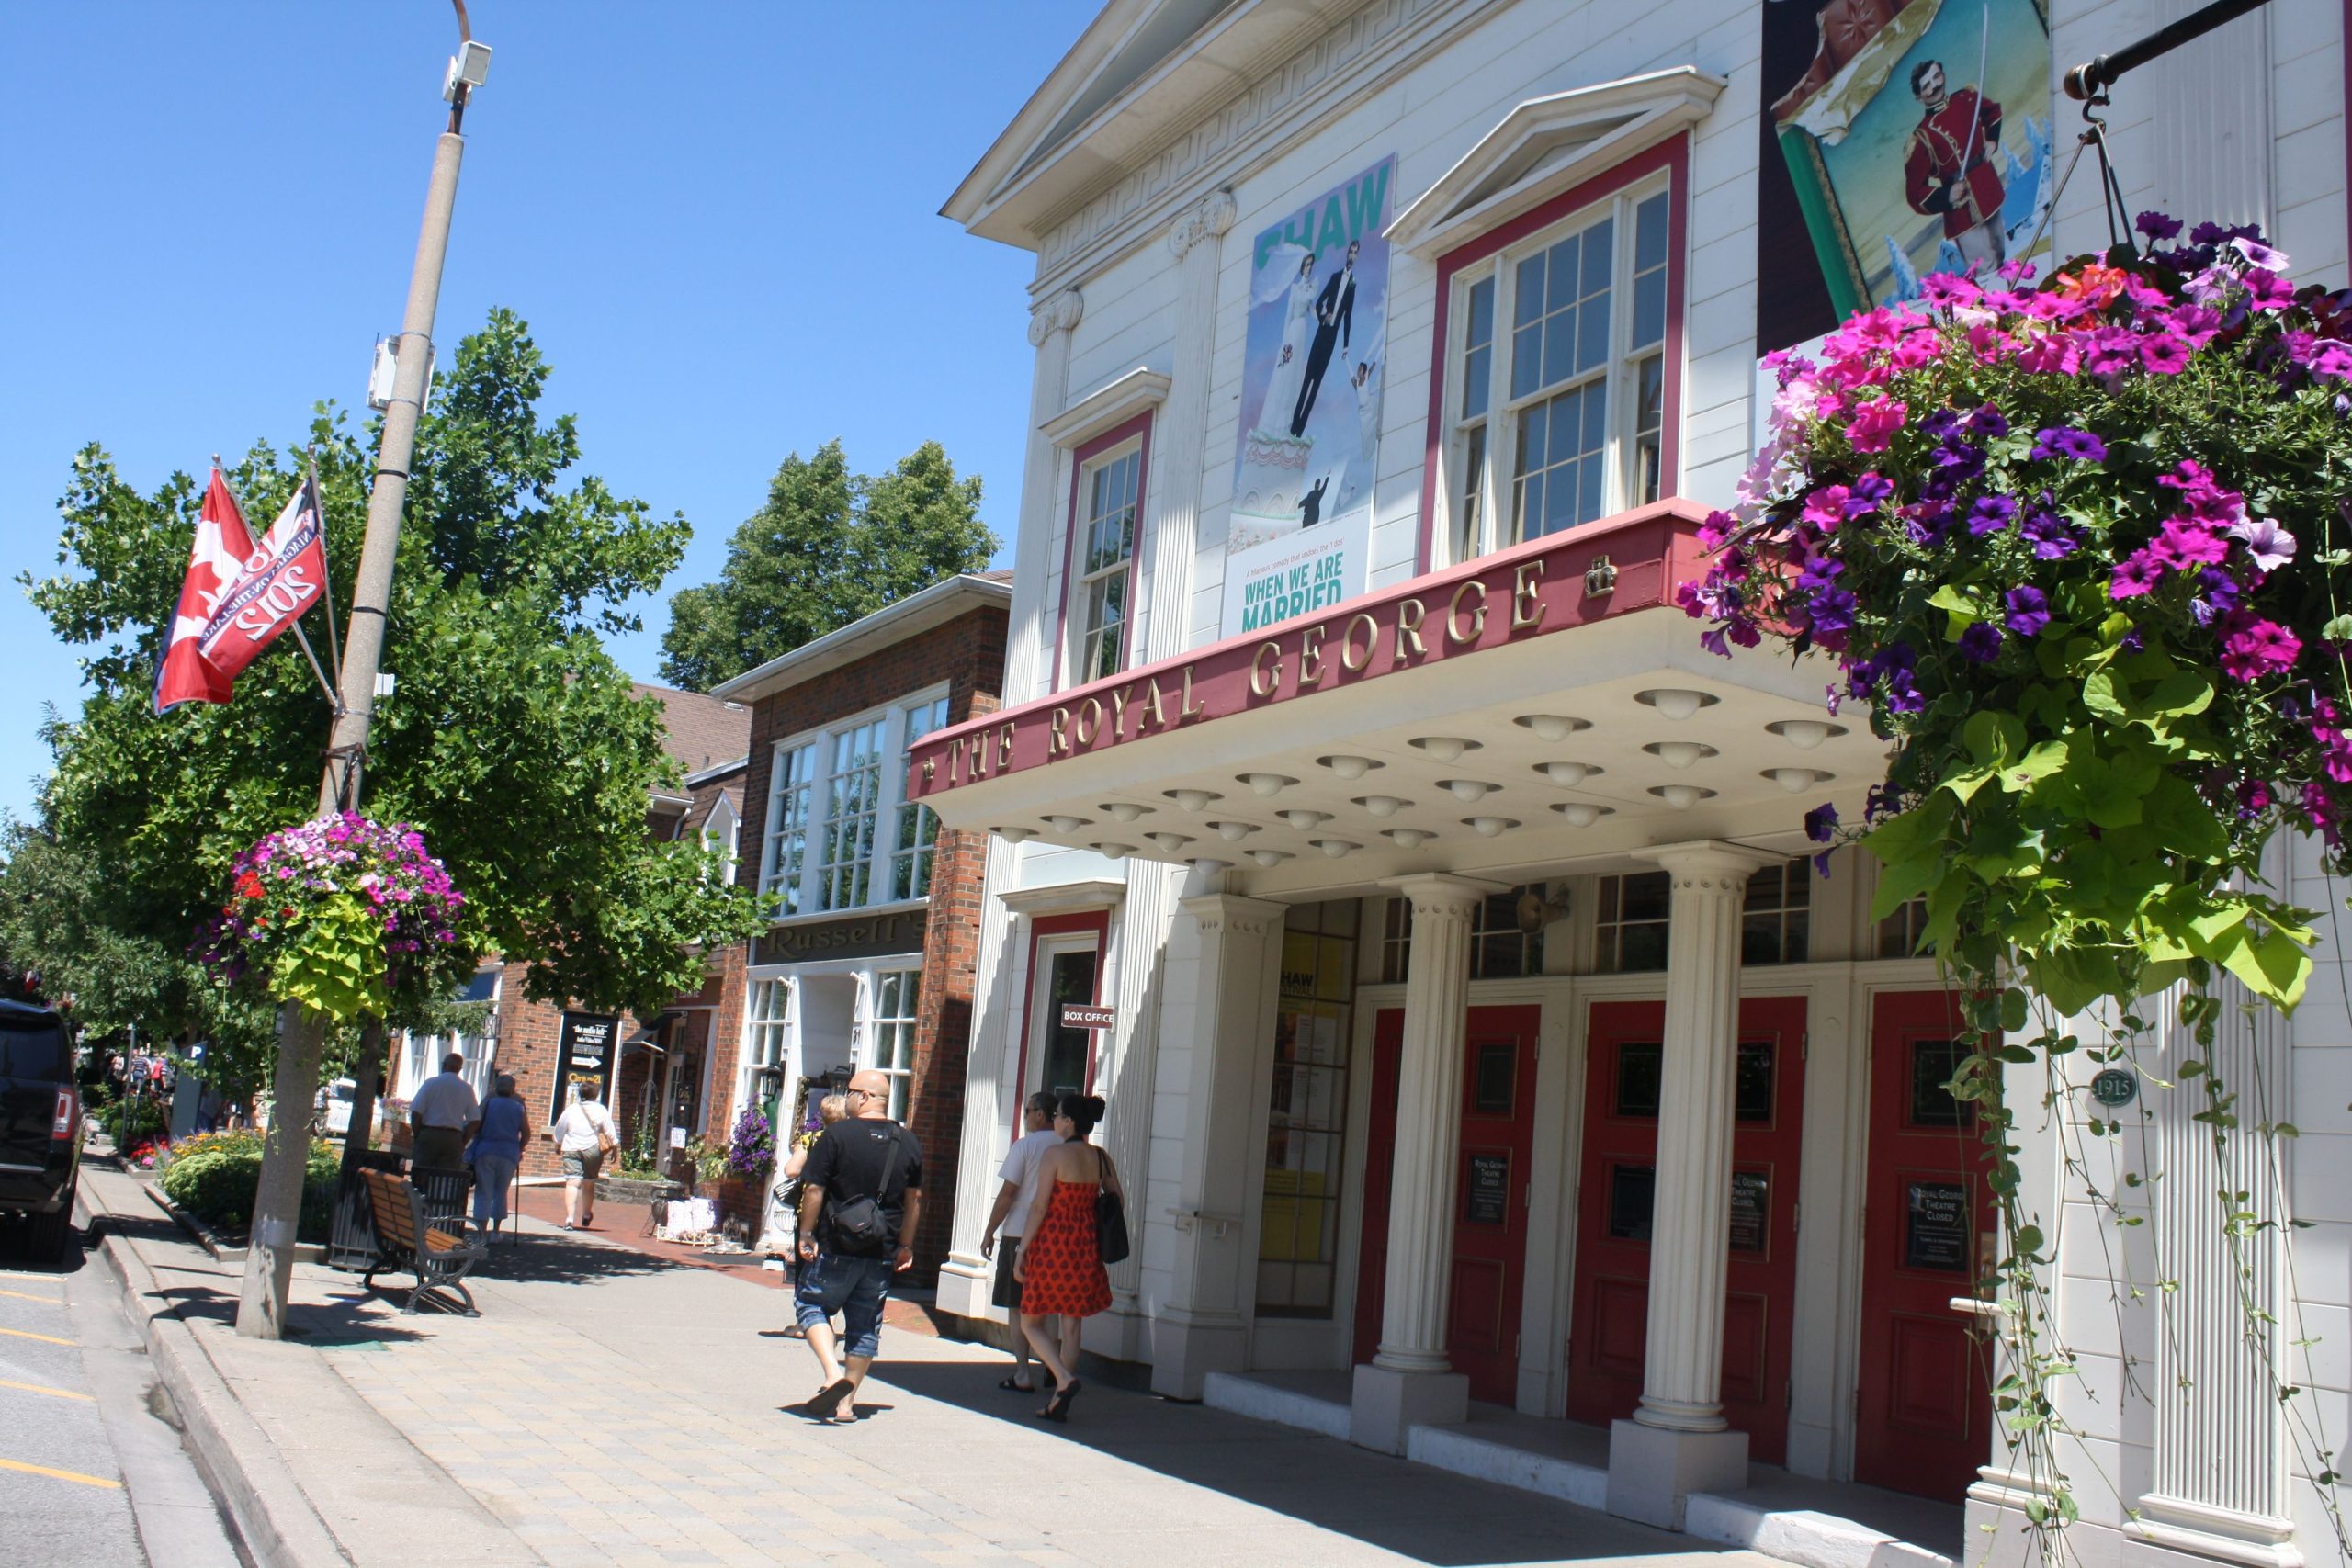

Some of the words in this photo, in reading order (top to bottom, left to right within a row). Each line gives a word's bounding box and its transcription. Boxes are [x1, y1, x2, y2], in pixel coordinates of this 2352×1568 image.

[1250, 564, 1271, 575] hilarious
[1271, 558, 1290, 571] comedy
[1290, 553, 1301, 563] that
[1319, 544, 1329, 552] the
[1245, 571, 1284, 606] WHEN
[1289, 563, 1310, 592] WE
[1314, 551, 1344, 583] ARE
[1241, 579, 1342, 634] MARRIED
[948, 722, 1015, 782] THE
[1049, 665, 1205, 756] ROYAL
[1250, 559, 1547, 698] GEORGE
[1064, 1011, 1083, 1021] BOX
[1085, 1012, 1114, 1023] OFFICE
[191, 1046, 202, 1058] P
[2096, 1079, 2130, 1096] 1915
[1939, 1190, 1963, 1201] GEORG
[1925, 1200, 1956, 1212] THEATRE
[1927, 1211, 1954, 1223] CLOSED
